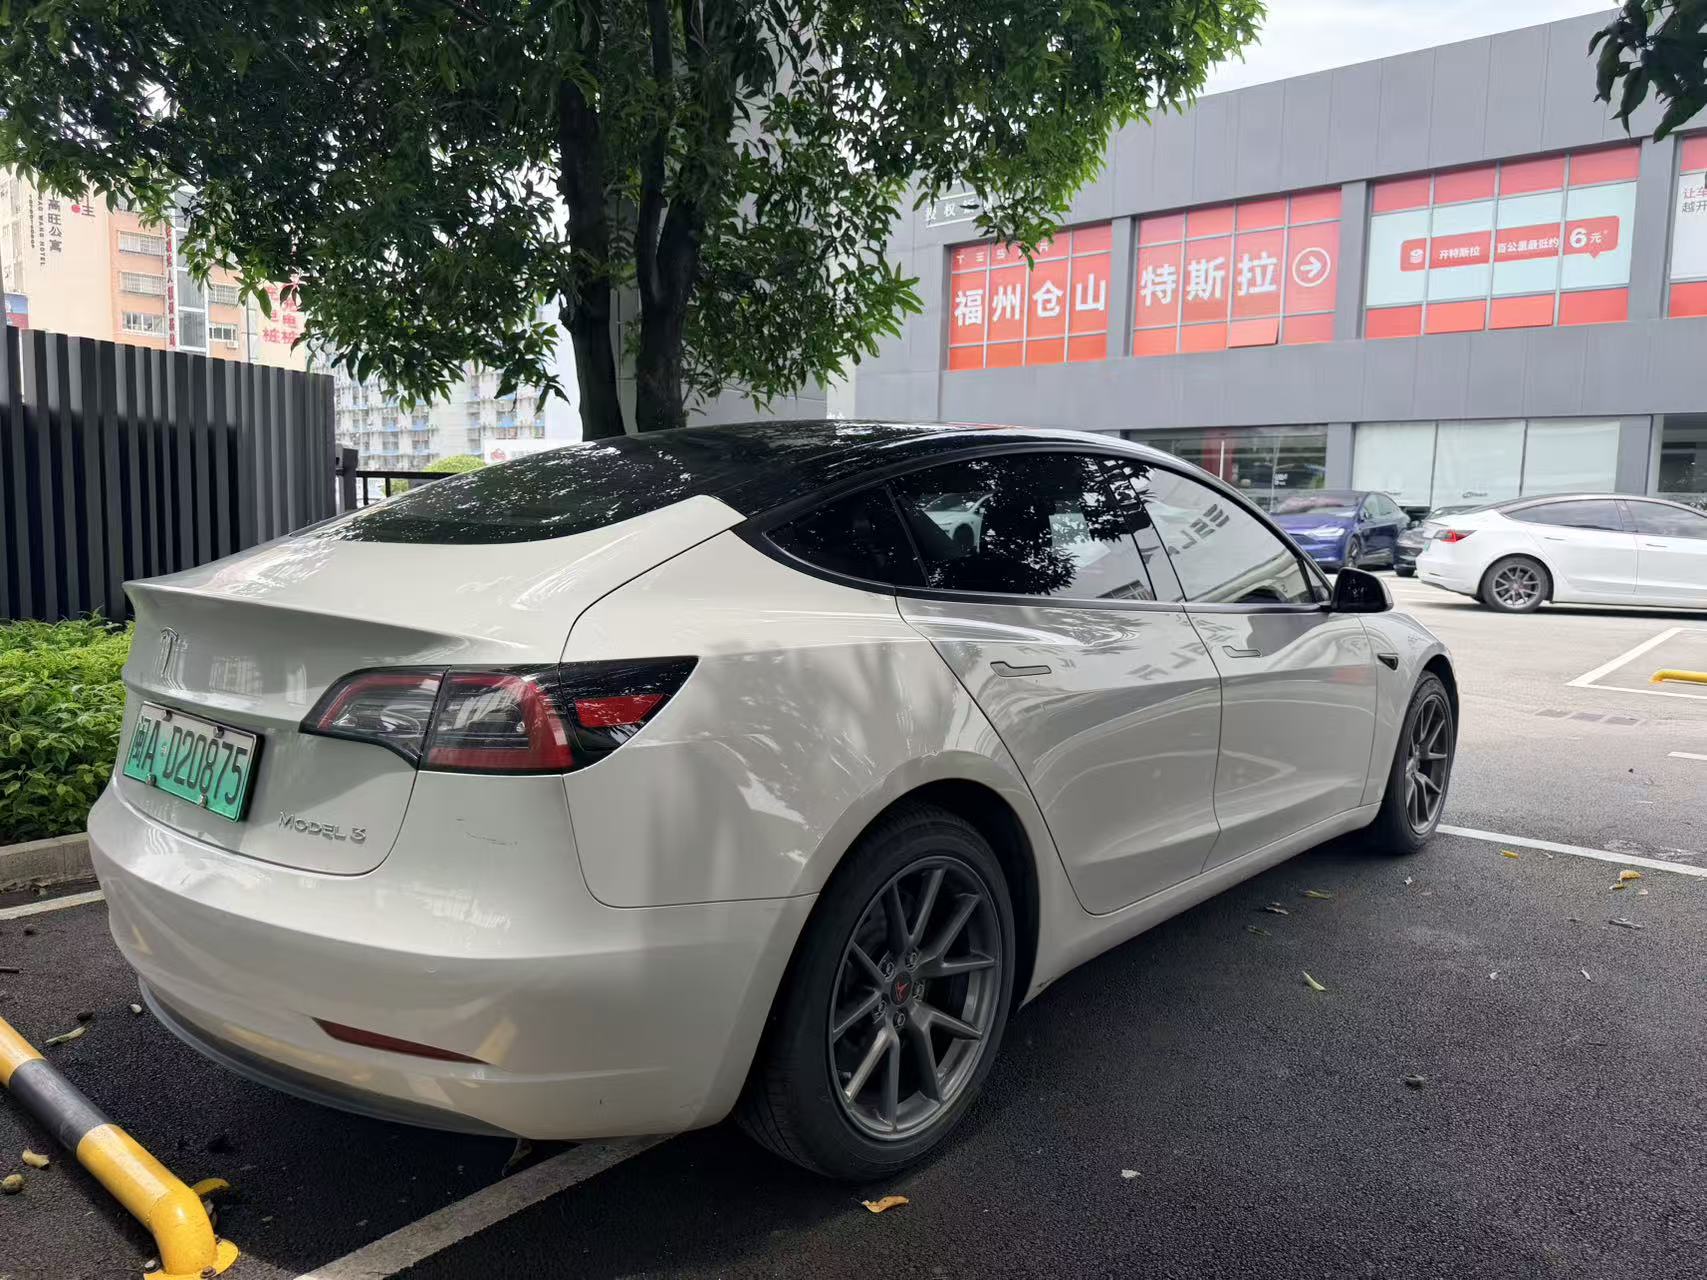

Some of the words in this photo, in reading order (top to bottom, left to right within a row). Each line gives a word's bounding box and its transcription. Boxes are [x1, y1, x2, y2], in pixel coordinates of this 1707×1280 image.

[956, 241, 1050, 265] TESA
[1438, 246, 1481, 260] 开特斯拉
[954, 272, 1107, 328] 福州仓山
[1140, 251, 1278, 308] 特斯拉
[279, 810, 347, 841] MODEL
[350, 826, 367, 845] 3
